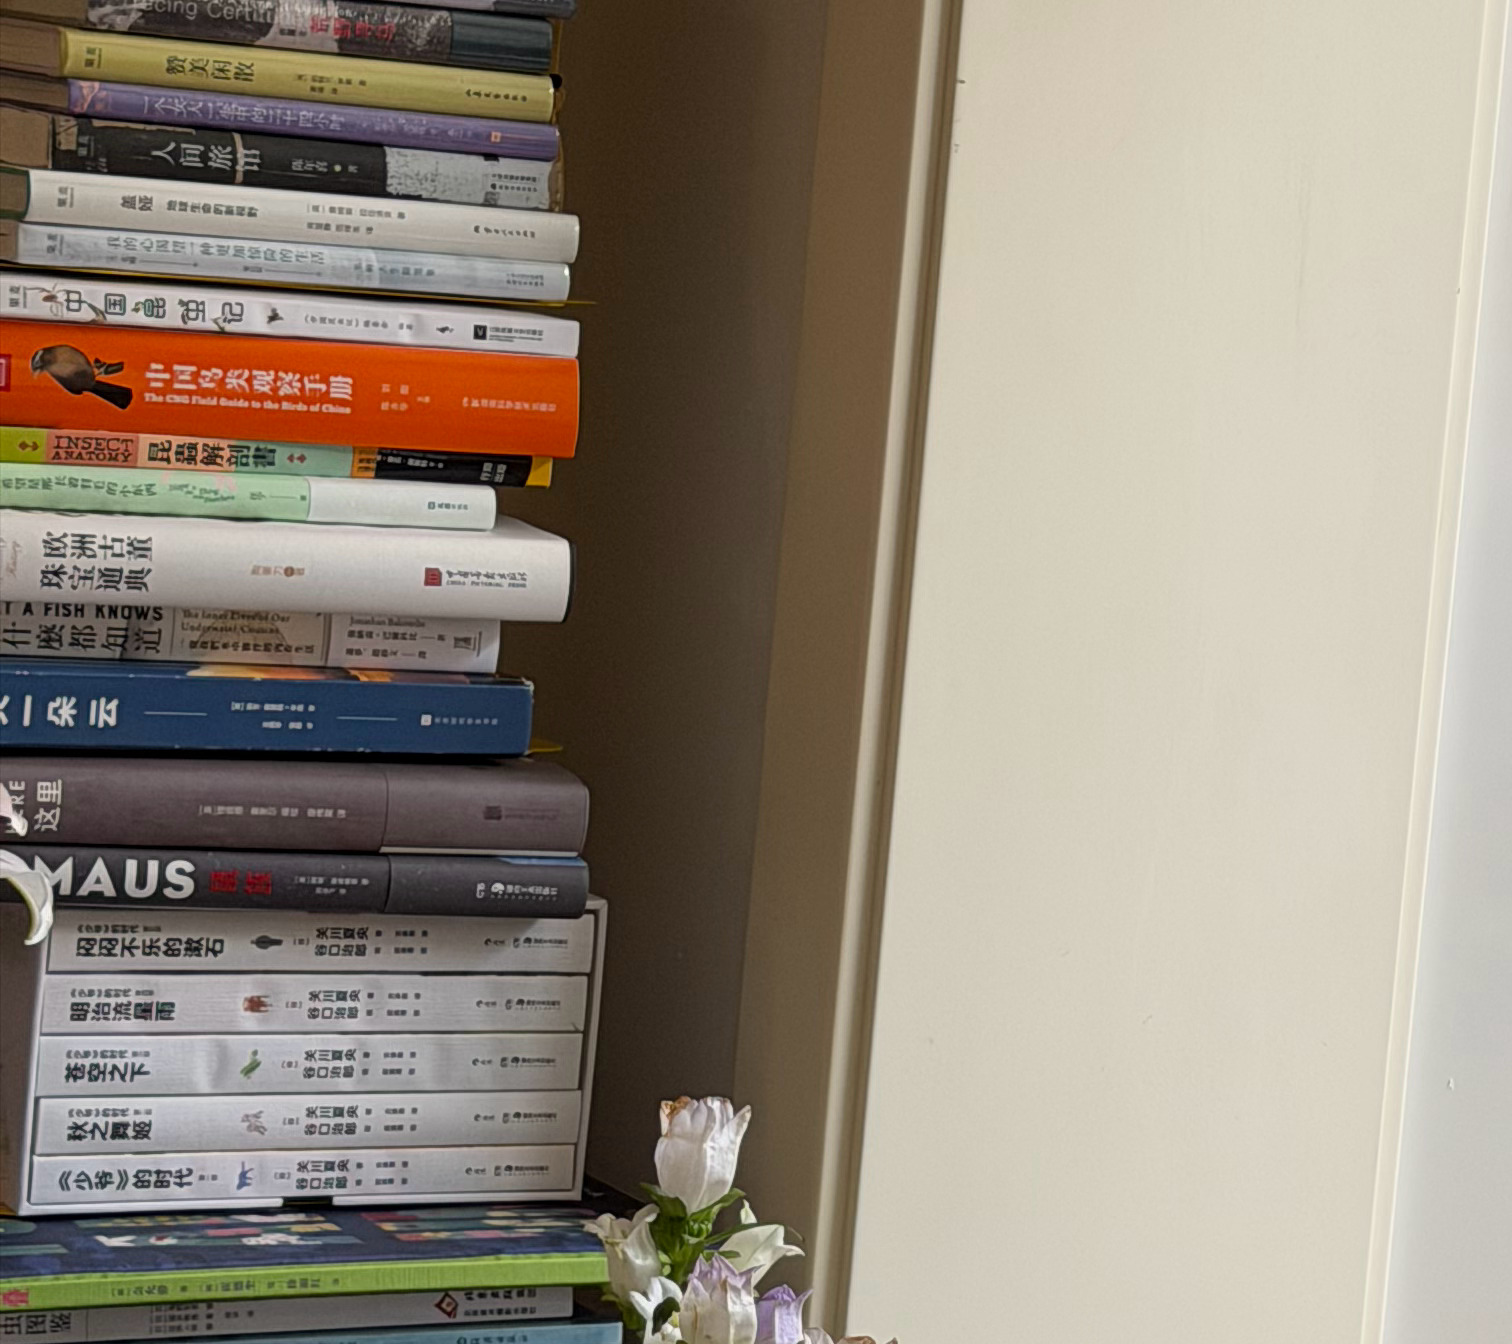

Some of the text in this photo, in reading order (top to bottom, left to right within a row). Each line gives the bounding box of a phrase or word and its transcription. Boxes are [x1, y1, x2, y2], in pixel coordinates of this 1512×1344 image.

[165, 55, 256, 83] 赞美闲散
[143, 95, 345, 131] 一个女人一生中的二十四小时
[152, 141, 261, 171] 人间旅馆
[120, 195, 154, 212] 盖娅
[107, 235, 326, 265] 我的心渴望一种更加惊险的生活
[64, 290, 245, 326] 中国昆虫记
[144, 363, 353, 400] 中国鸟类观察手册
[144, 392, 164, 403] The
[191, 395, 217, 406] Field
[219, 397, 249, 408] Guide
[251, 400, 261, 409] to
[263, 400, 279, 410] the
[281, 401, 308, 412] Birds
[310, 402, 320, 412] of
[322, 404, 351, 415] China
[54, 436, 133, 452] INSECT
[148, 439, 277, 468] 昆蟲解剖書
[52, 449, 132, 463] ANATOMY
[42, 531, 153, 561] 欧洲古董
[40, 564, 153, 592] 珠宝通典
[22, 601, 163, 622] A FISH KNOWS
[2, 621, 162, 654] 什麼都知道
[5, 780, 26, 834] HRE
[34, 779, 62, 833] 这里
[34, 855, 196, 899] MAUS
[316, 927, 369, 940] 关川夏央
[76, 937, 225, 958] 闷闷不乐的漱石
[315, 944, 367, 957] 谷口治郎
[309, 989, 361, 1003] 关川夏央
[70, 1001, 176, 1022] 明治流星雨
[307, 1006, 358, 1020] 谷口治郎
[304, 1048, 357, 1062] 关川夏央
[65, 1061, 151, 1083] 苍空之下
[303, 1065, 355, 1079] 谷口治郎
[305, 1105, 359, 1119] 关川夏央
[67, 1119, 153, 1141] 秋之舞姬
[304, 1122, 357, 1136] 谷口治郎
[296, 1159, 350, 1173] 关川夏央
[58, 1167, 194, 1192] 《少爷》的时代
[295, 1176, 348, 1190] 谷口治郎
[0, 1312, 72, 1335] 虫图鉴
